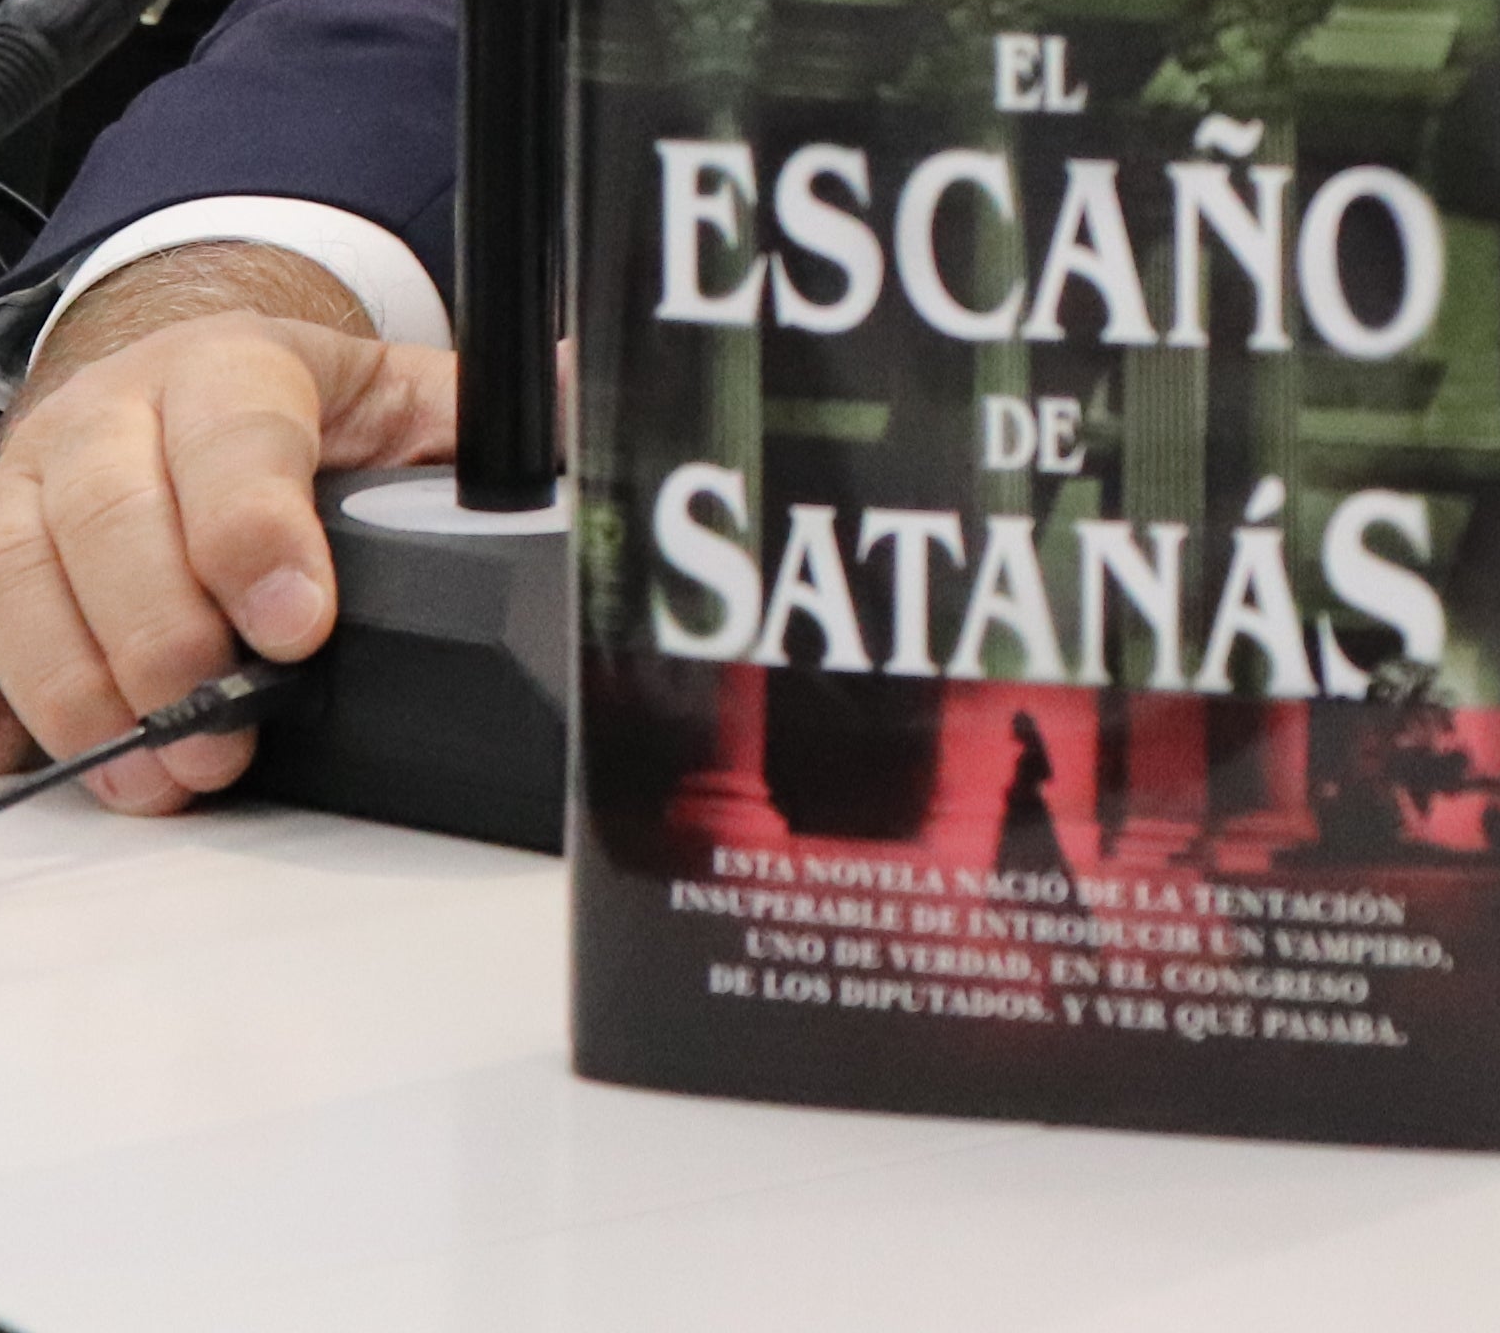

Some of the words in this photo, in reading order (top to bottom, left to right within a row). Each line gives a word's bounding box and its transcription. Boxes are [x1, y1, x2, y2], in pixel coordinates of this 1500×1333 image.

[994, 34, 1088, 113] EL
[654, 113, 1445, 359] ESCAÑO
[984, 396, 1087, 474] DE
[651, 461, 1447, 700] SATANÁS
[670, 879, 900, 930] INSUPERABLE
[911, 904, 957, 935] DE
[967, 907, 1201, 951] INTRODUCIR
[1210, 924, 1265, 957] UN
[713, 845, 795, 882] ESTA
[804, 854, 946, 896] NOVELA
[954, 864, 1070, 904] NACIÓ
[1076, 874, 1125, 907] DE
[1134, 880, 1182, 913] LA
[1193, 882, 1405, 926] TENTACIÓN
[709, 962, 756, 997] DE
[763, 967, 832, 1005] LOS
[1062, 993, 1087, 1026] Y
[1095, 996, 1167, 1031] VER
[1173, 999, 1255, 1042] QUÉ
[745, 926, 826, 965] UNO
[833, 937, 883, 970] DE
[1050, 952, 1098, 986] EN
[1109, 957, 1154, 990] EL
[1162, 962, 1369, 1004] CONGRESO
